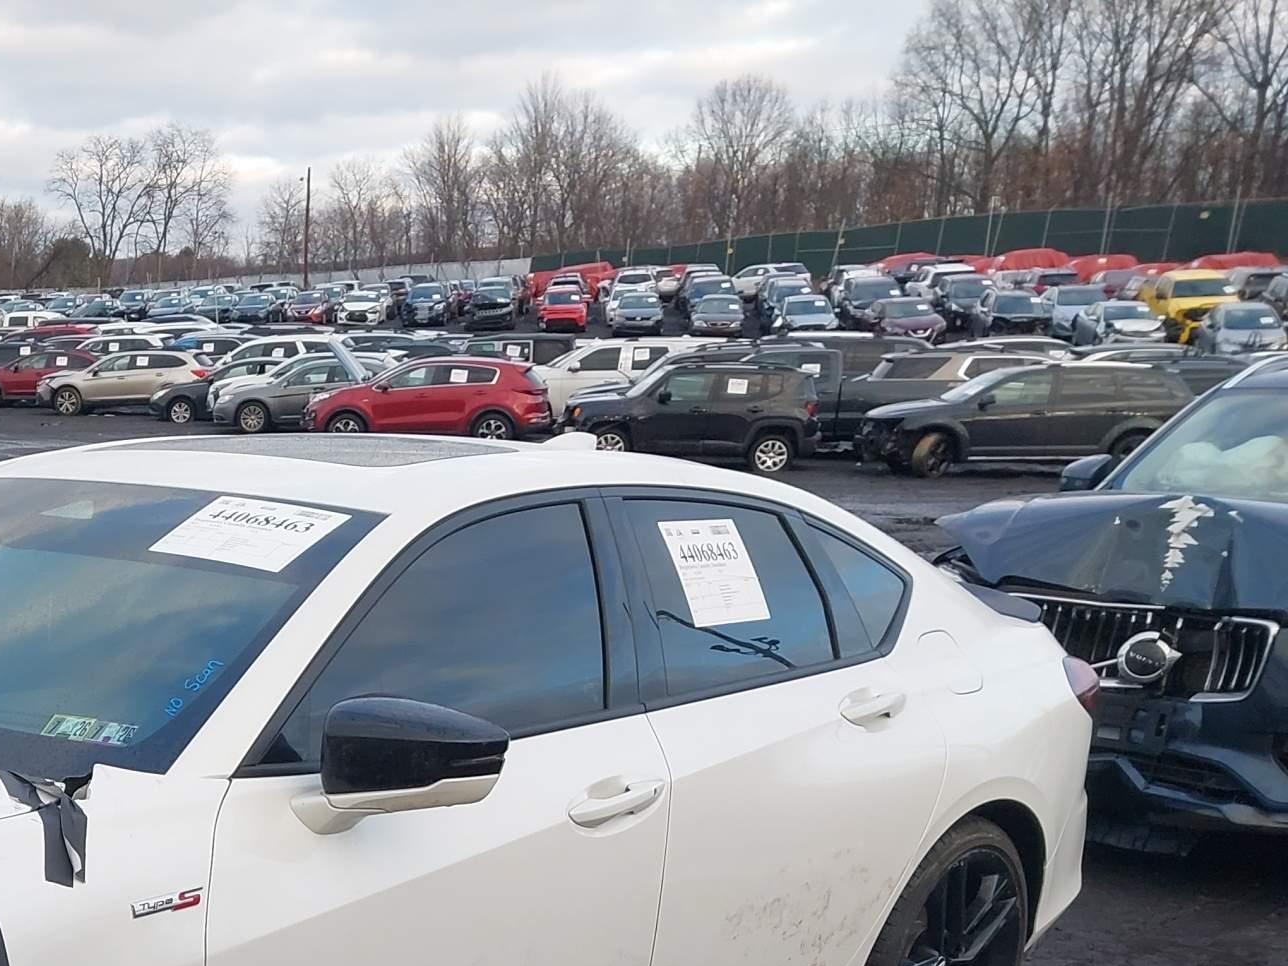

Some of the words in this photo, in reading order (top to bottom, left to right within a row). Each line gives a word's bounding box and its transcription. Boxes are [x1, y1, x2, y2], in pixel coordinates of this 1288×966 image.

[208, 509, 316, 534] 44068463
[679, 541, 739, 563] 44068463
[139, 897, 174, 911] Type
